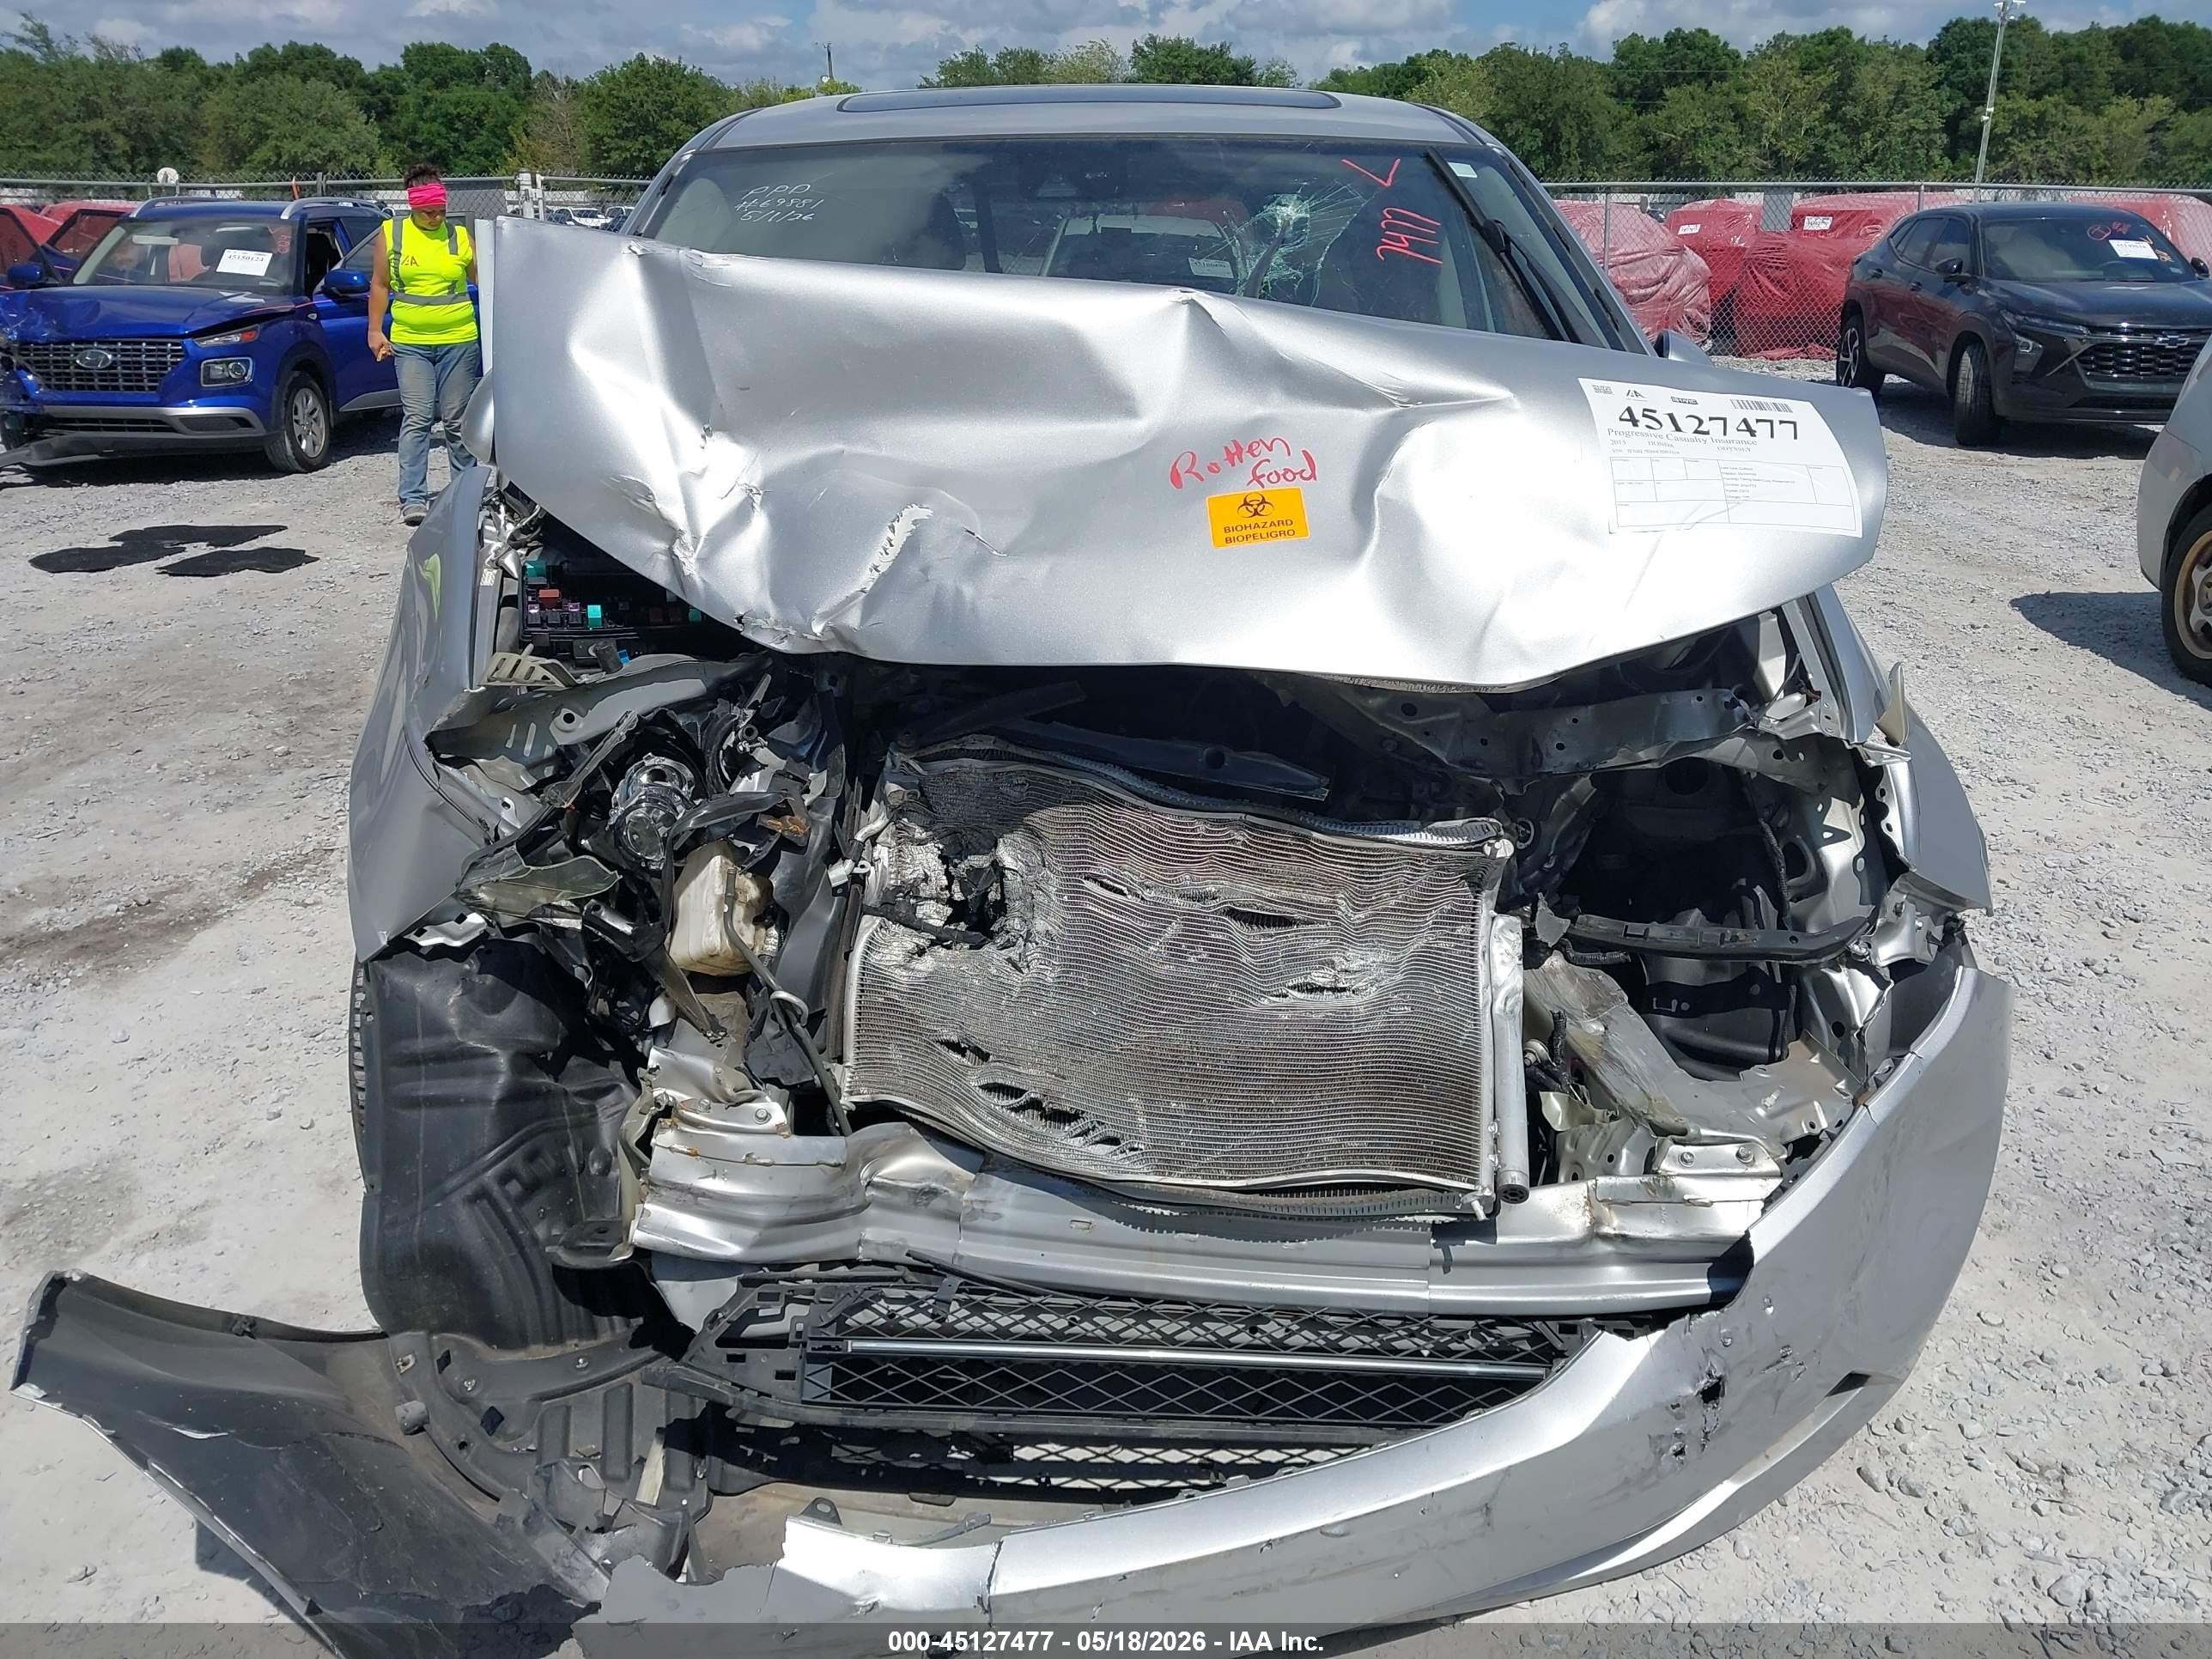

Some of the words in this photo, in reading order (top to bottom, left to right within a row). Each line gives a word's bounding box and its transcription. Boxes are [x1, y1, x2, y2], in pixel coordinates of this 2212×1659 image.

[1619, 405, 1798, 440] 45127477
[1607, 428, 1663, 440] Progressive
[1666, 434, 1707, 445] Casualty
[1711, 436, 1758, 446] Insurance
[1224, 519, 1293, 533] BIOHAZARD
[1224, 529, 1296, 544] BIOPELIGRO
